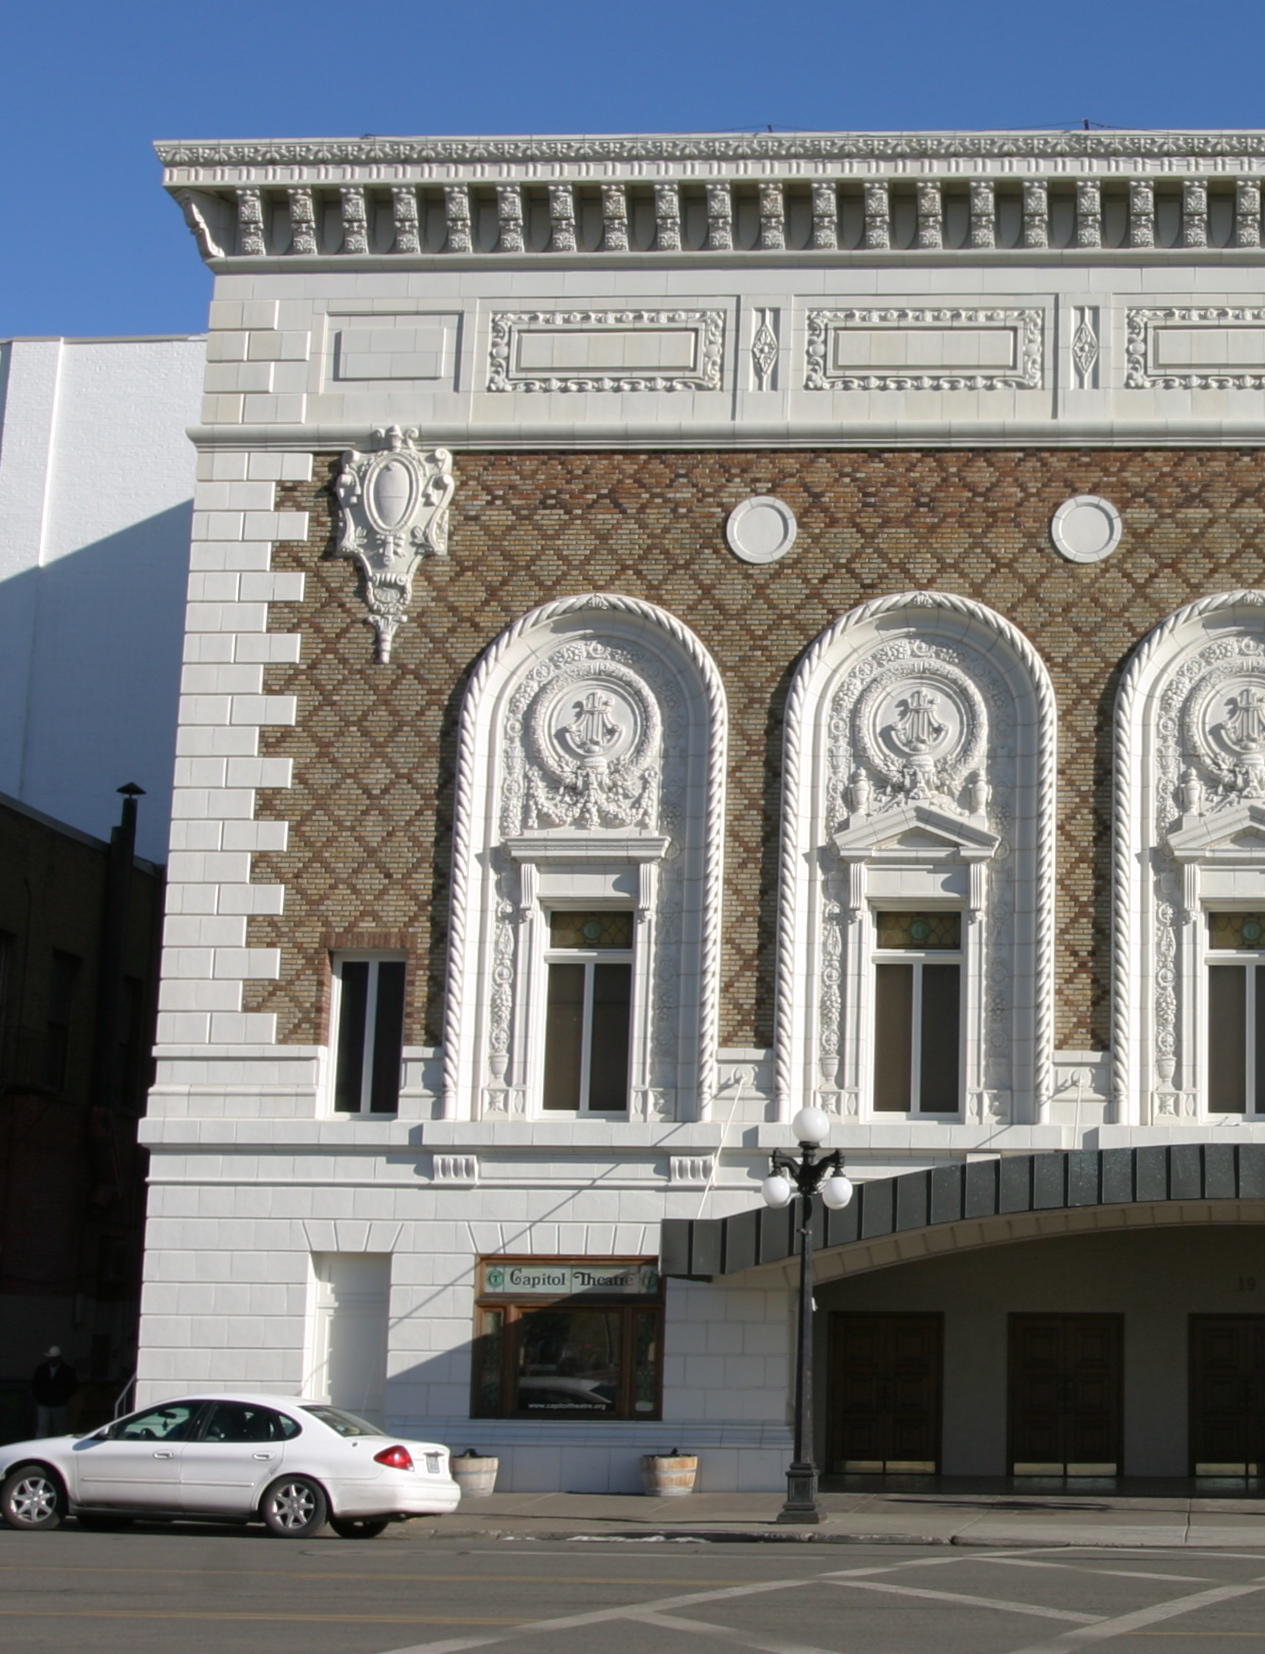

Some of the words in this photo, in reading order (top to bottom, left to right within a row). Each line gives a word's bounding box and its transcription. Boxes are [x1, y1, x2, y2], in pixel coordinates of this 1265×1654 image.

[510, 1269, 566, 1288] Capitol
[573, 1271, 636, 1286] Theatre
[1238, 1276, 1256, 1292] 19
[528, 1402, 607, 1411] www.capitoltheatre.org
